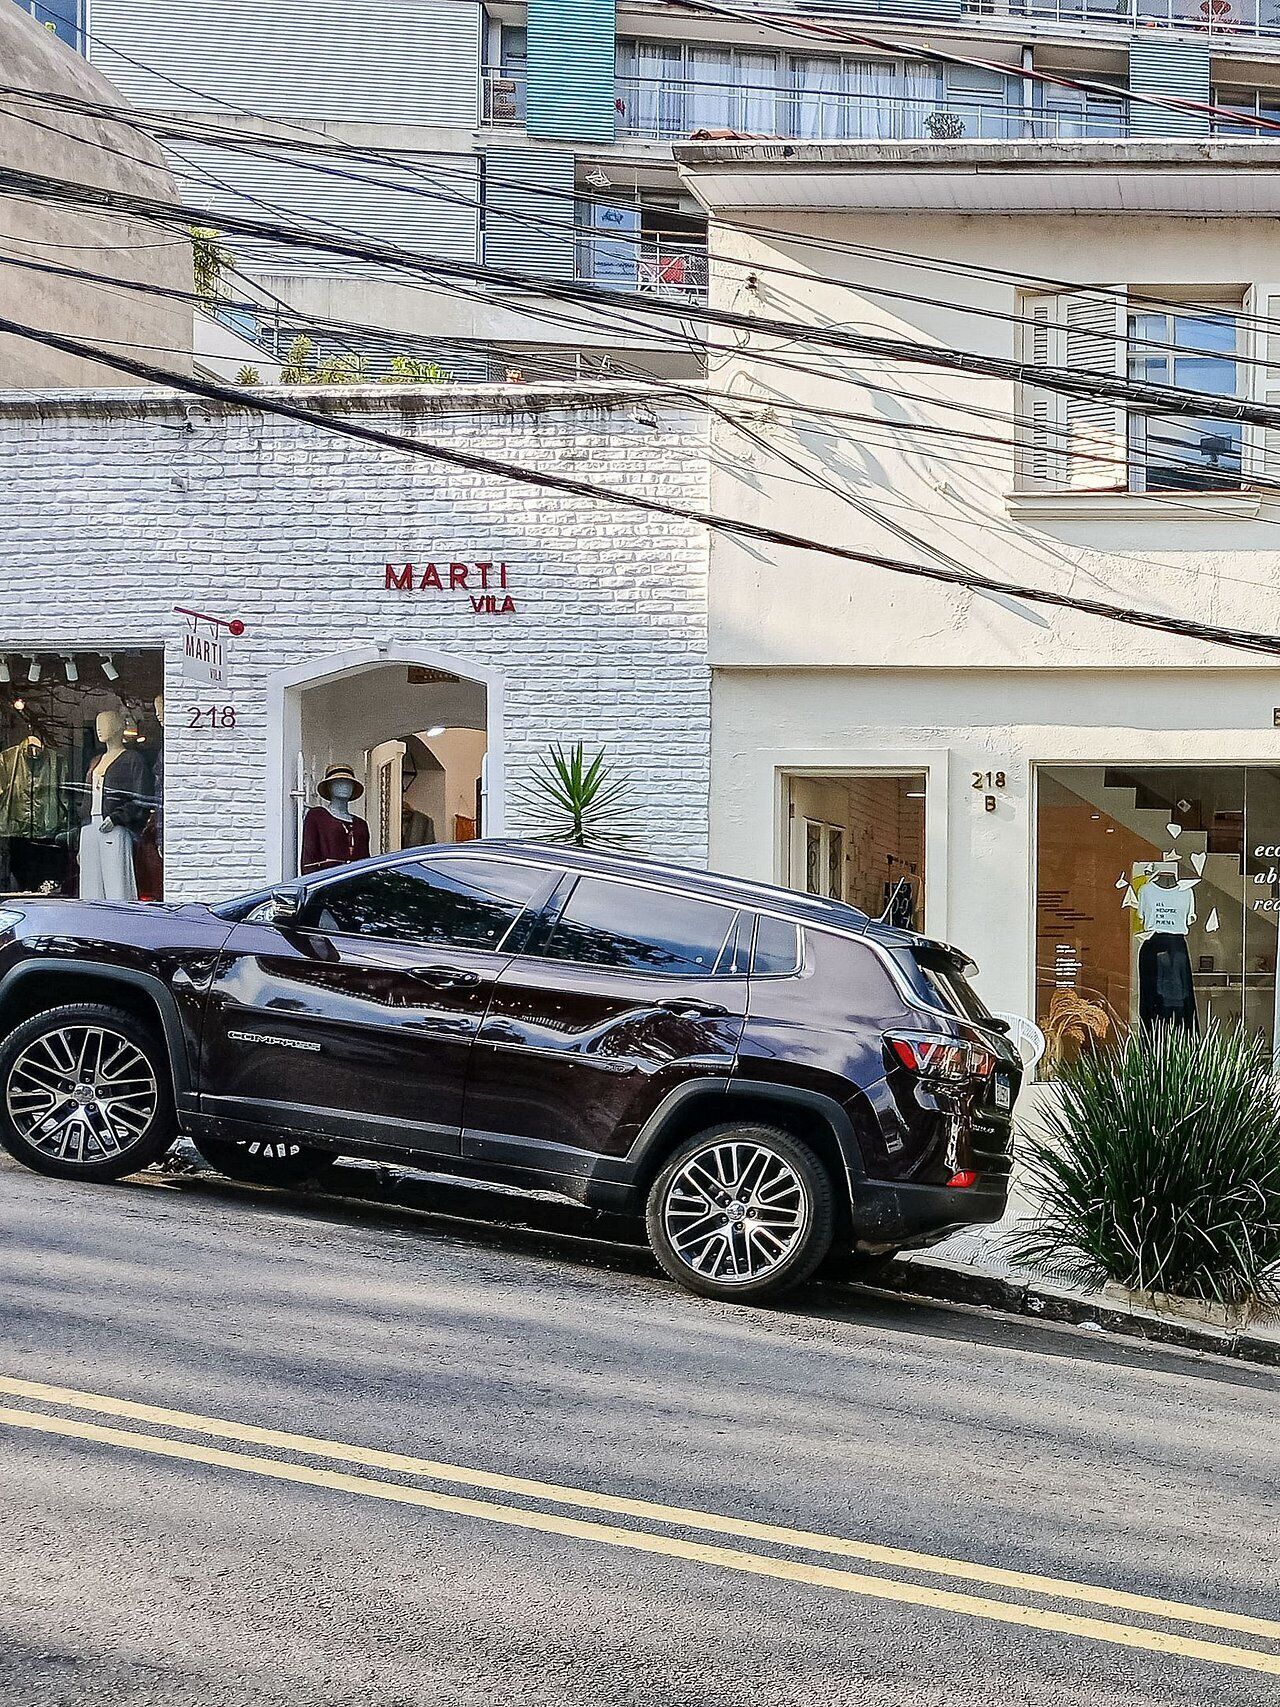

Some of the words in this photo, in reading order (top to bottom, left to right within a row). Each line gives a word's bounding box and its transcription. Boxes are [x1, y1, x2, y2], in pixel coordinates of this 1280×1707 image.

[385, 562, 507, 591] MARTI
[469, 595, 517, 613] VILA
[185, 634, 222, 666] MARTI
[187, 705, 236, 729] 218
[971, 771, 1006, 789] 218
[984, 796, 997, 812] B
[227, 1030, 321, 1051] COMPASS
